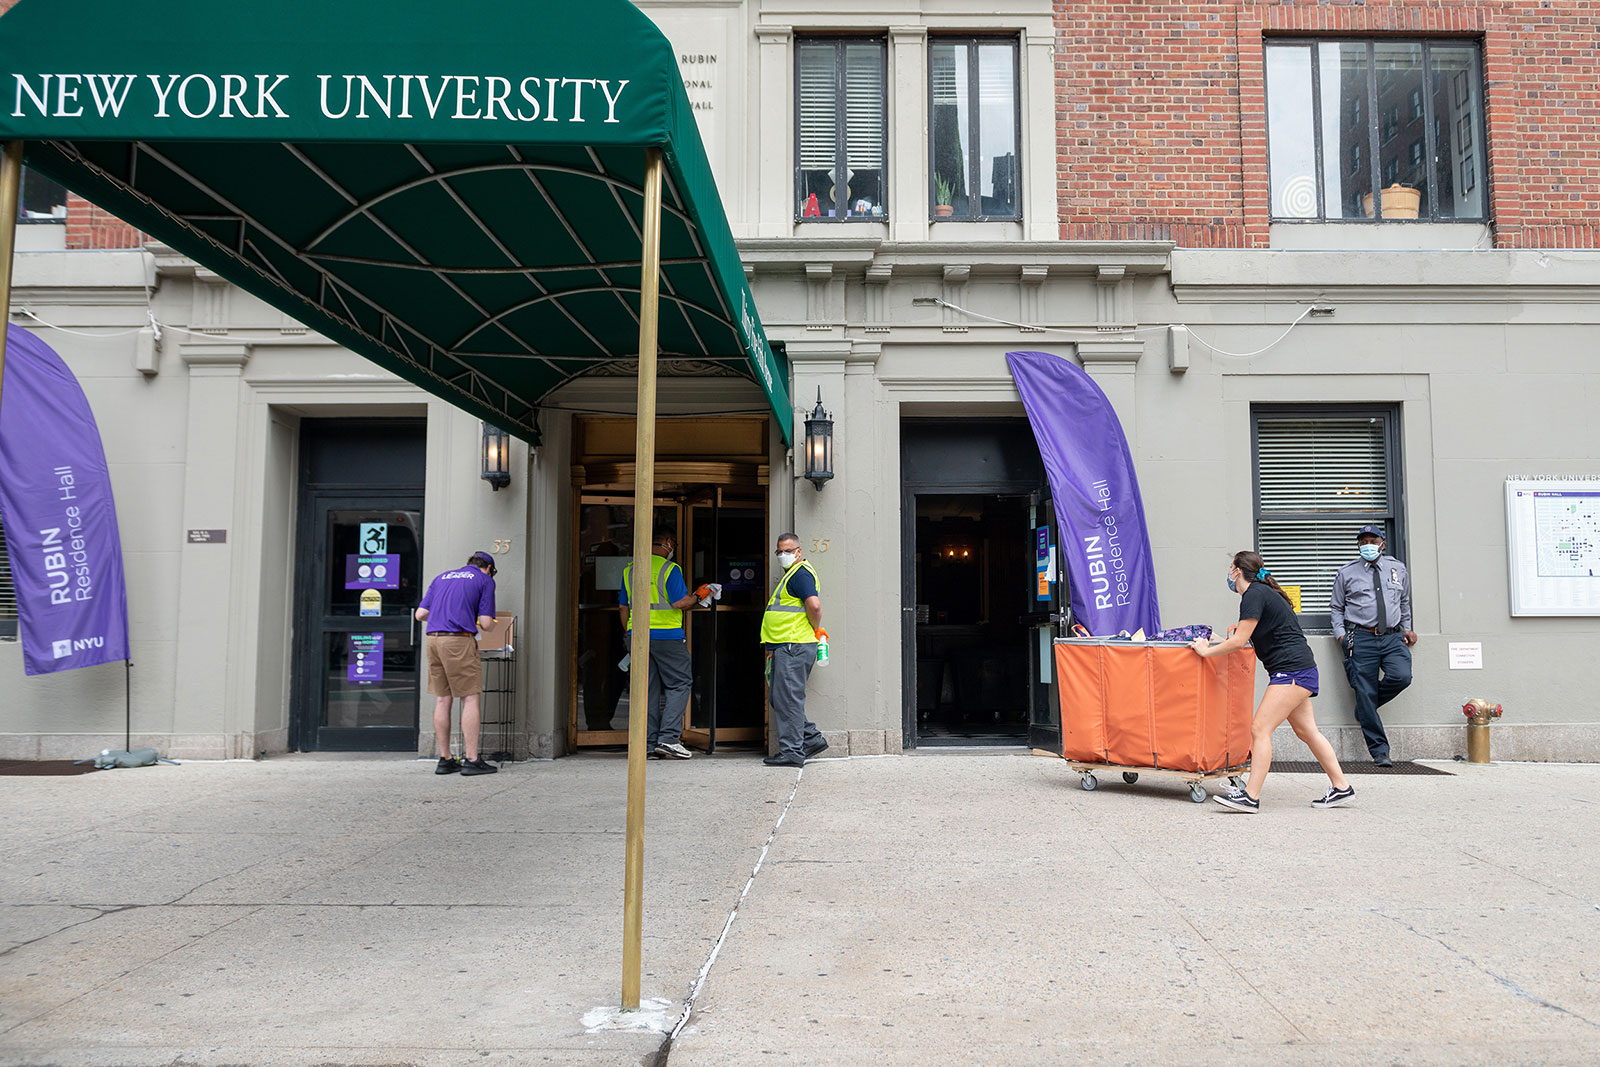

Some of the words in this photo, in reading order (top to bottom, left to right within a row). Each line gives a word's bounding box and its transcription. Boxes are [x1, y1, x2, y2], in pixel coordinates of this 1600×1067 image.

[681, 54, 717, 64] RUBIN
[11, 73, 138, 118] NEW
[146, 73, 290, 119] YORK
[316, 74, 631, 123] UNIVERSITY
[53, 465, 77, 501] Hall
[1092, 479, 1113, 512] Hall
[65, 505, 93, 602] Residence
[490, 539, 512, 555] 35
[809, 538, 832, 554] 35
[1105, 515, 1131, 607] Residence
[39, 525, 72, 605] RUBIN
[1084, 535, 1114, 610] RUBIN
[73, 636, 104, 651] NYU
